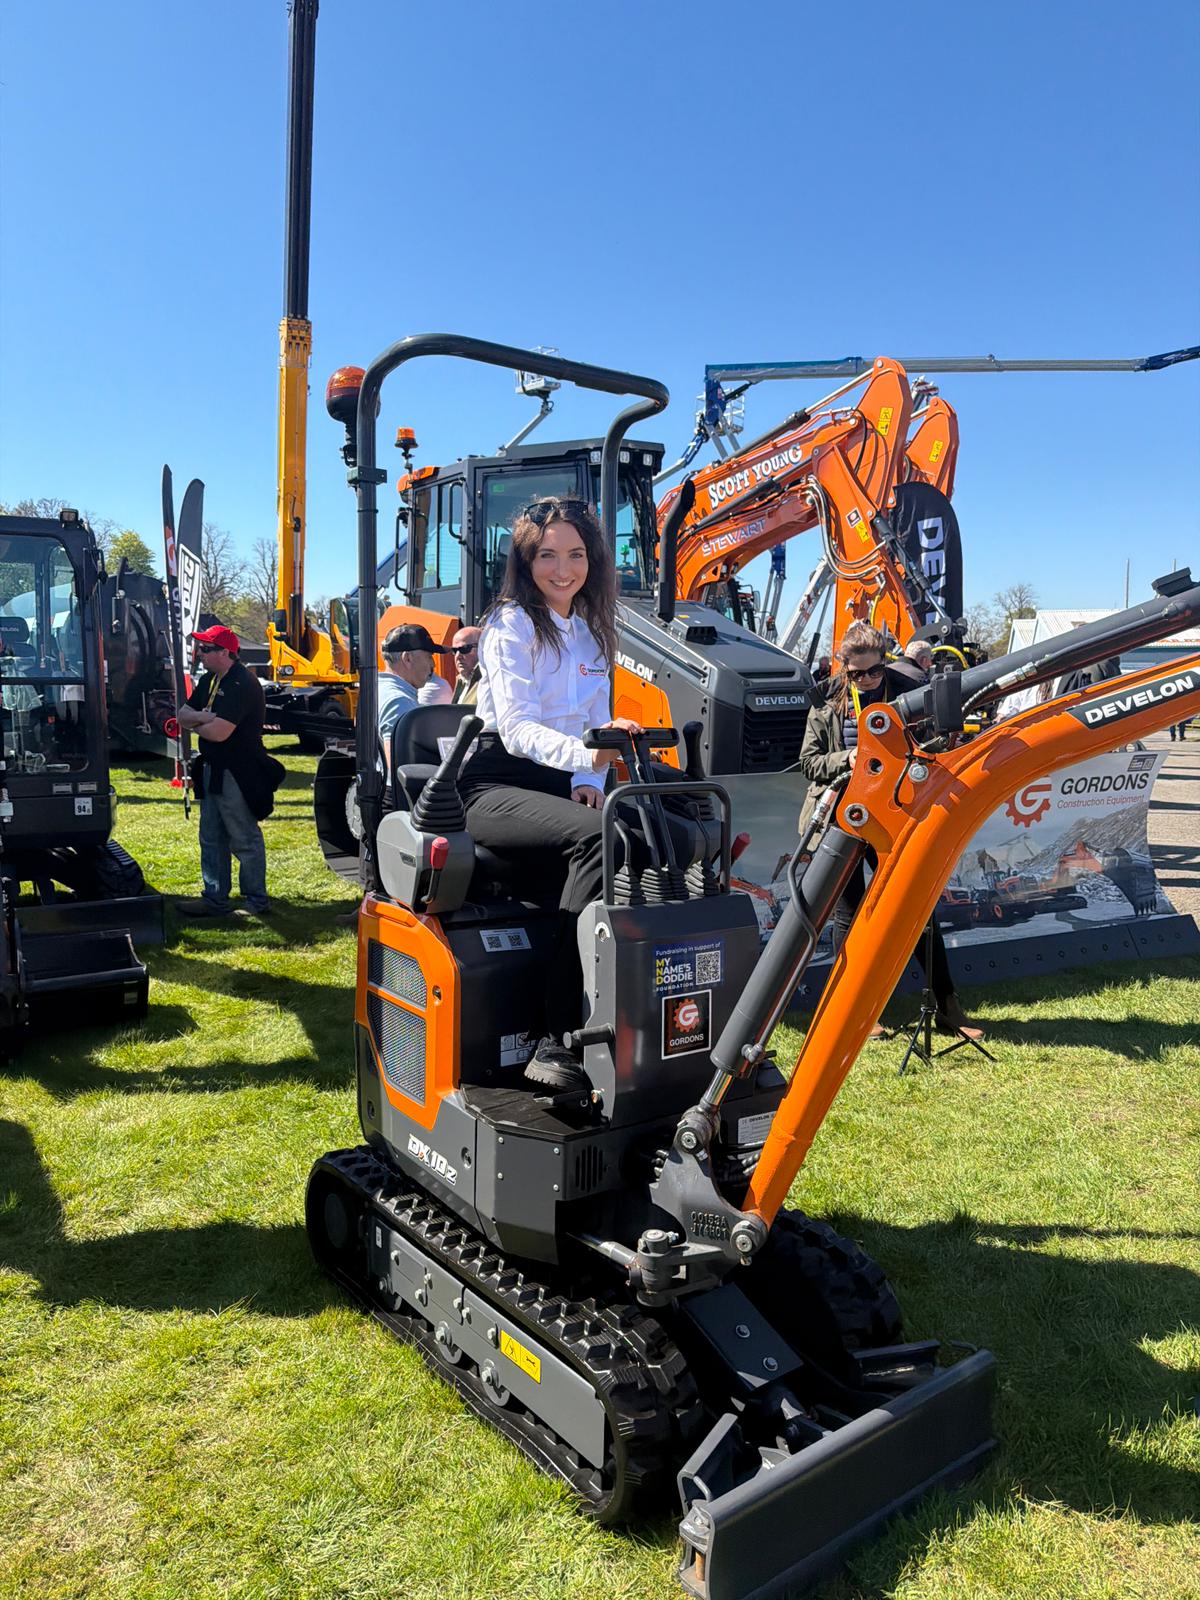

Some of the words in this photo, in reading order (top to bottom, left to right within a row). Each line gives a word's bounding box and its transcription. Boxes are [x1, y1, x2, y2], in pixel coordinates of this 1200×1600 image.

[708, 469, 750, 510] SCOTT
[752, 443, 803, 480] YOUNG
[701, 518, 767, 557] STEWART
[614, 650, 655, 682] VELON
[755, 695, 805, 706] DEVELON
[1084, 675, 1195, 724] DEVELON
[1060, 772, 1150, 796] GORDONS
[1056, 798, 1105, 810] Construction
[1106, 794, 1145, 806] Equipment
[655, 947, 688, 957] Fundraising
[694, 943, 715, 951] support
[656, 957, 671, 968] MY
[656, 963, 692, 976] NAME'S
[656, 971, 694, 985] DODDIE
[656, 982, 694, 992] FOUNDATION
[669, 1033, 704, 1047] GORDONS
